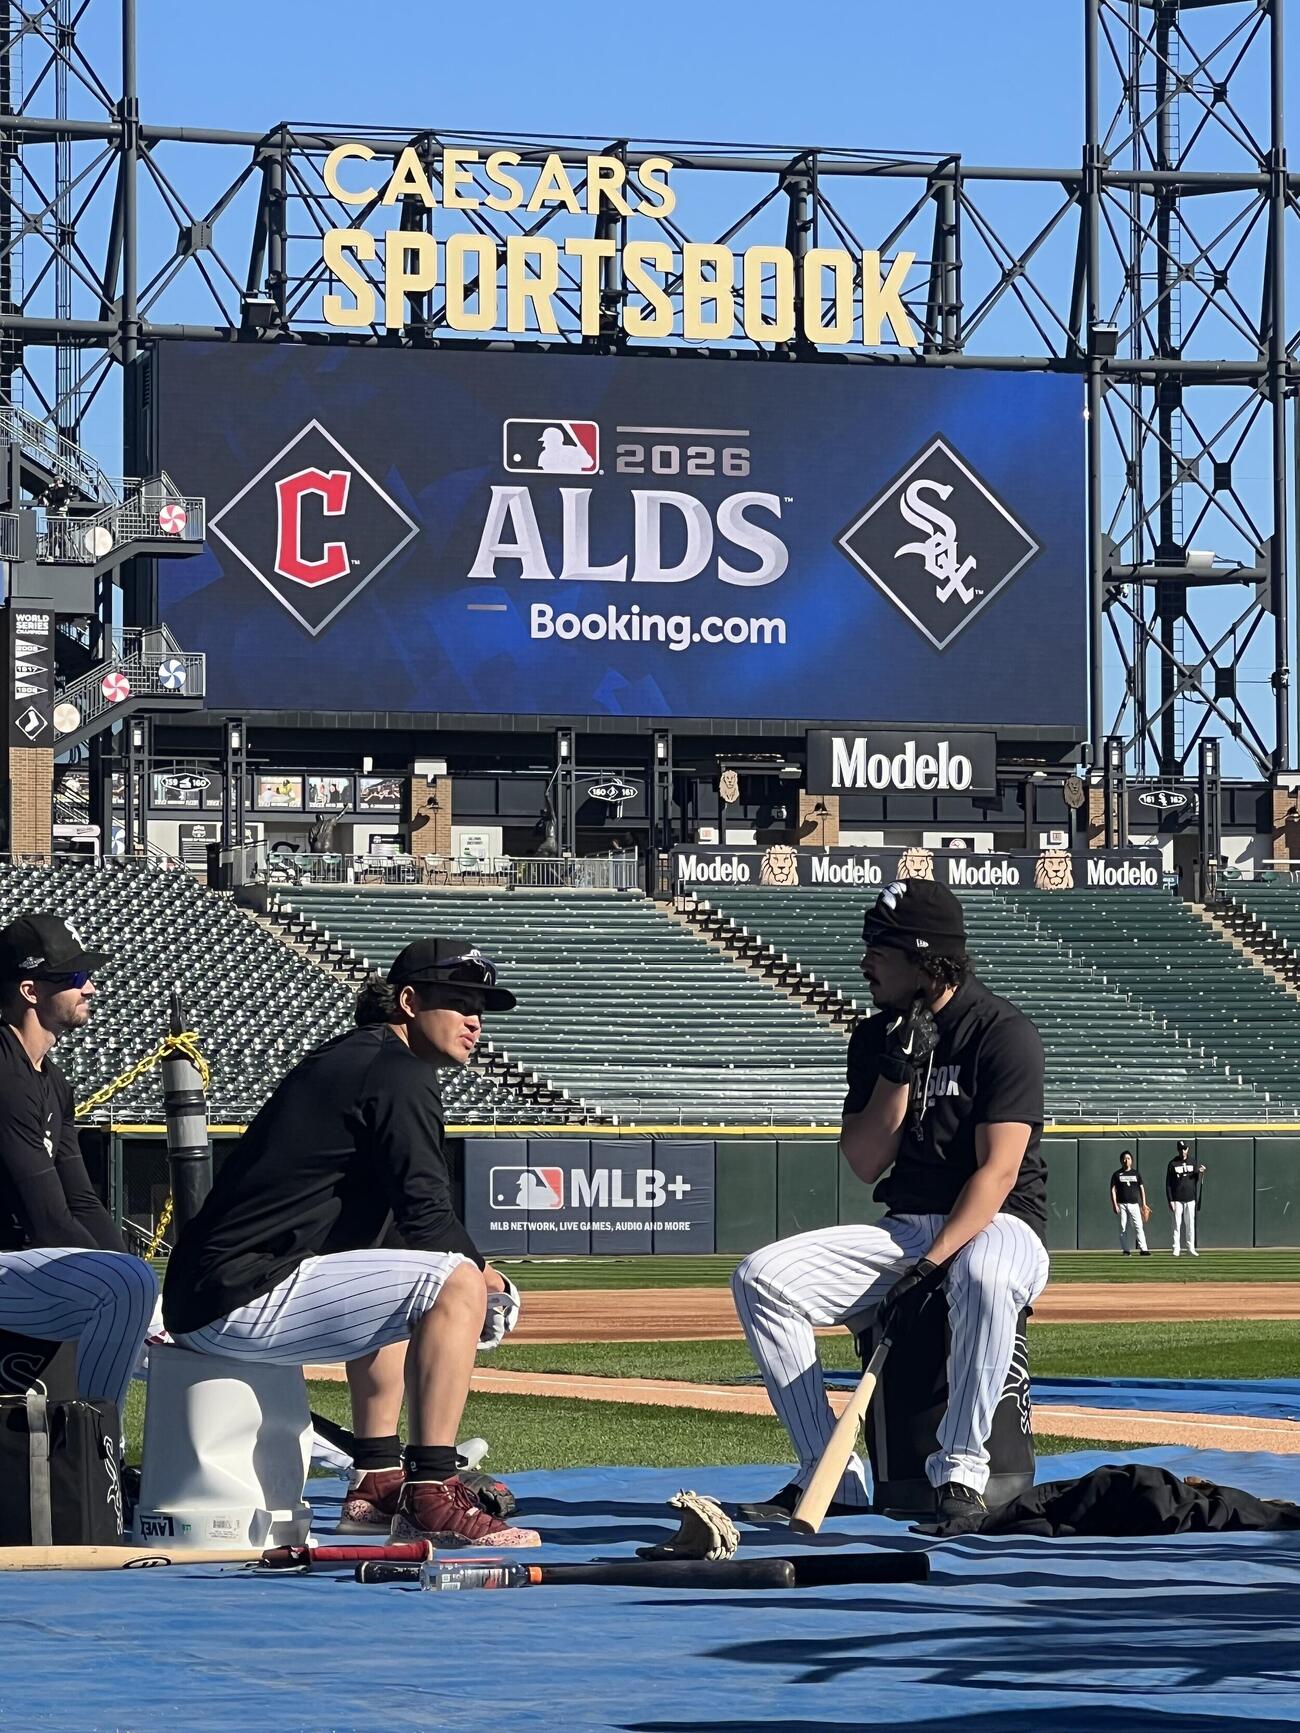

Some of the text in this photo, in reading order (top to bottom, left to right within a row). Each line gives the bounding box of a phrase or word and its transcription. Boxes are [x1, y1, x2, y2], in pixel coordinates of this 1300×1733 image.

[323, 143, 677, 219] CAESARS
[322, 228, 918, 348] SPORTSBOOK
[616, 444, 751, 477] 2026
[274, 466, 351, 588] C
[467, 485, 789, 587] ALDS
[15, 613, 50, 622] WORLD
[15, 621, 49, 630] SERIES
[530, 603, 787, 651] Booking.com
[831, 737, 973, 791] Modelo
[678, 854, 750, 882] Modelo
[811, 856, 882, 884] Modelo
[948, 858, 1020, 886] Modelo
[1087, 859, 1158, 887] Modelo
[570, 1168, 691, 1208] MLB+
[490, 1221, 691, 1232] MLB NETWORK, LIVE GAMES, AUDIO AND MORE
